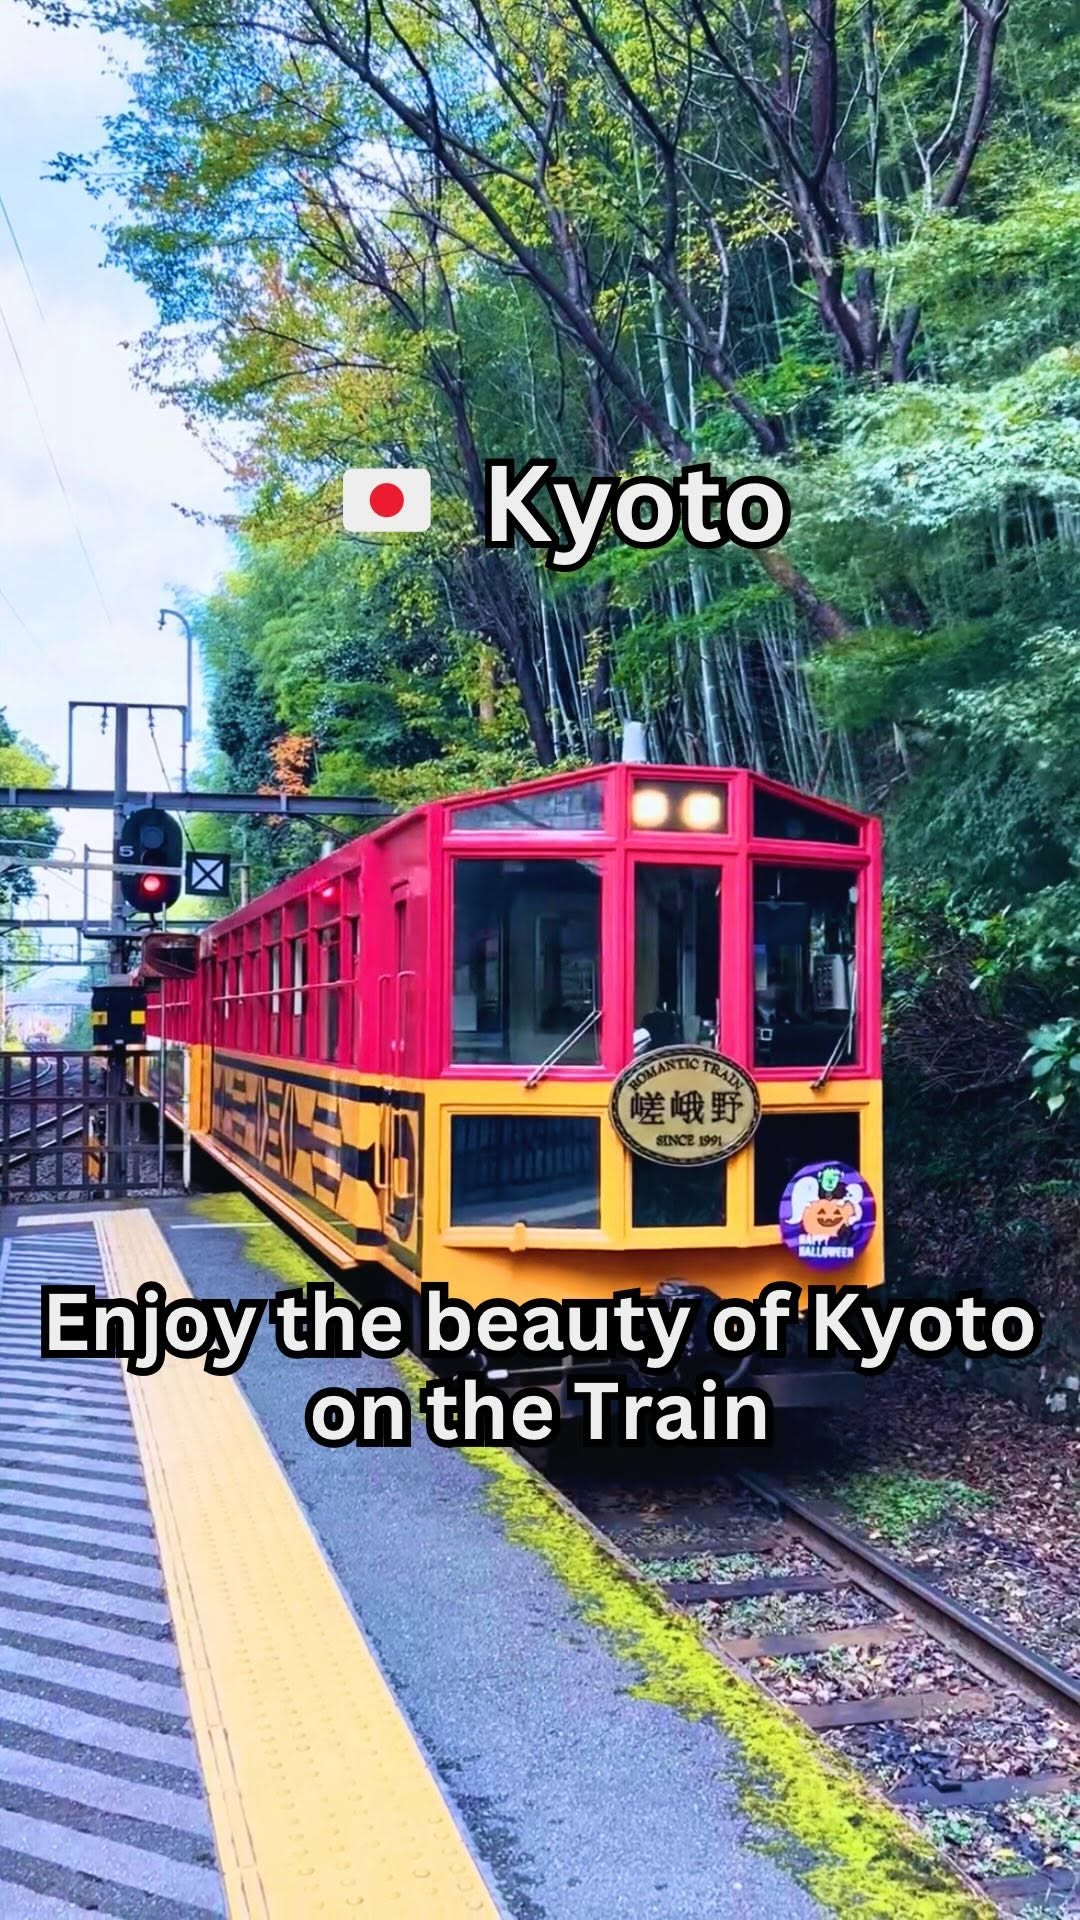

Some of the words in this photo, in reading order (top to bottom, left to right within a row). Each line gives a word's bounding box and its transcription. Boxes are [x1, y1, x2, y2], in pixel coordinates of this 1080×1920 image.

[119, 846, 134, 857] 5
[628, 1057, 700, 1091] ROMANTIC
[702, 1060, 744, 1090] TRAIN
[630, 1089, 743, 1125] 嵯峨野
[656, 1134, 695, 1146] SINCE
[698, 1135, 722, 1147] 1991
